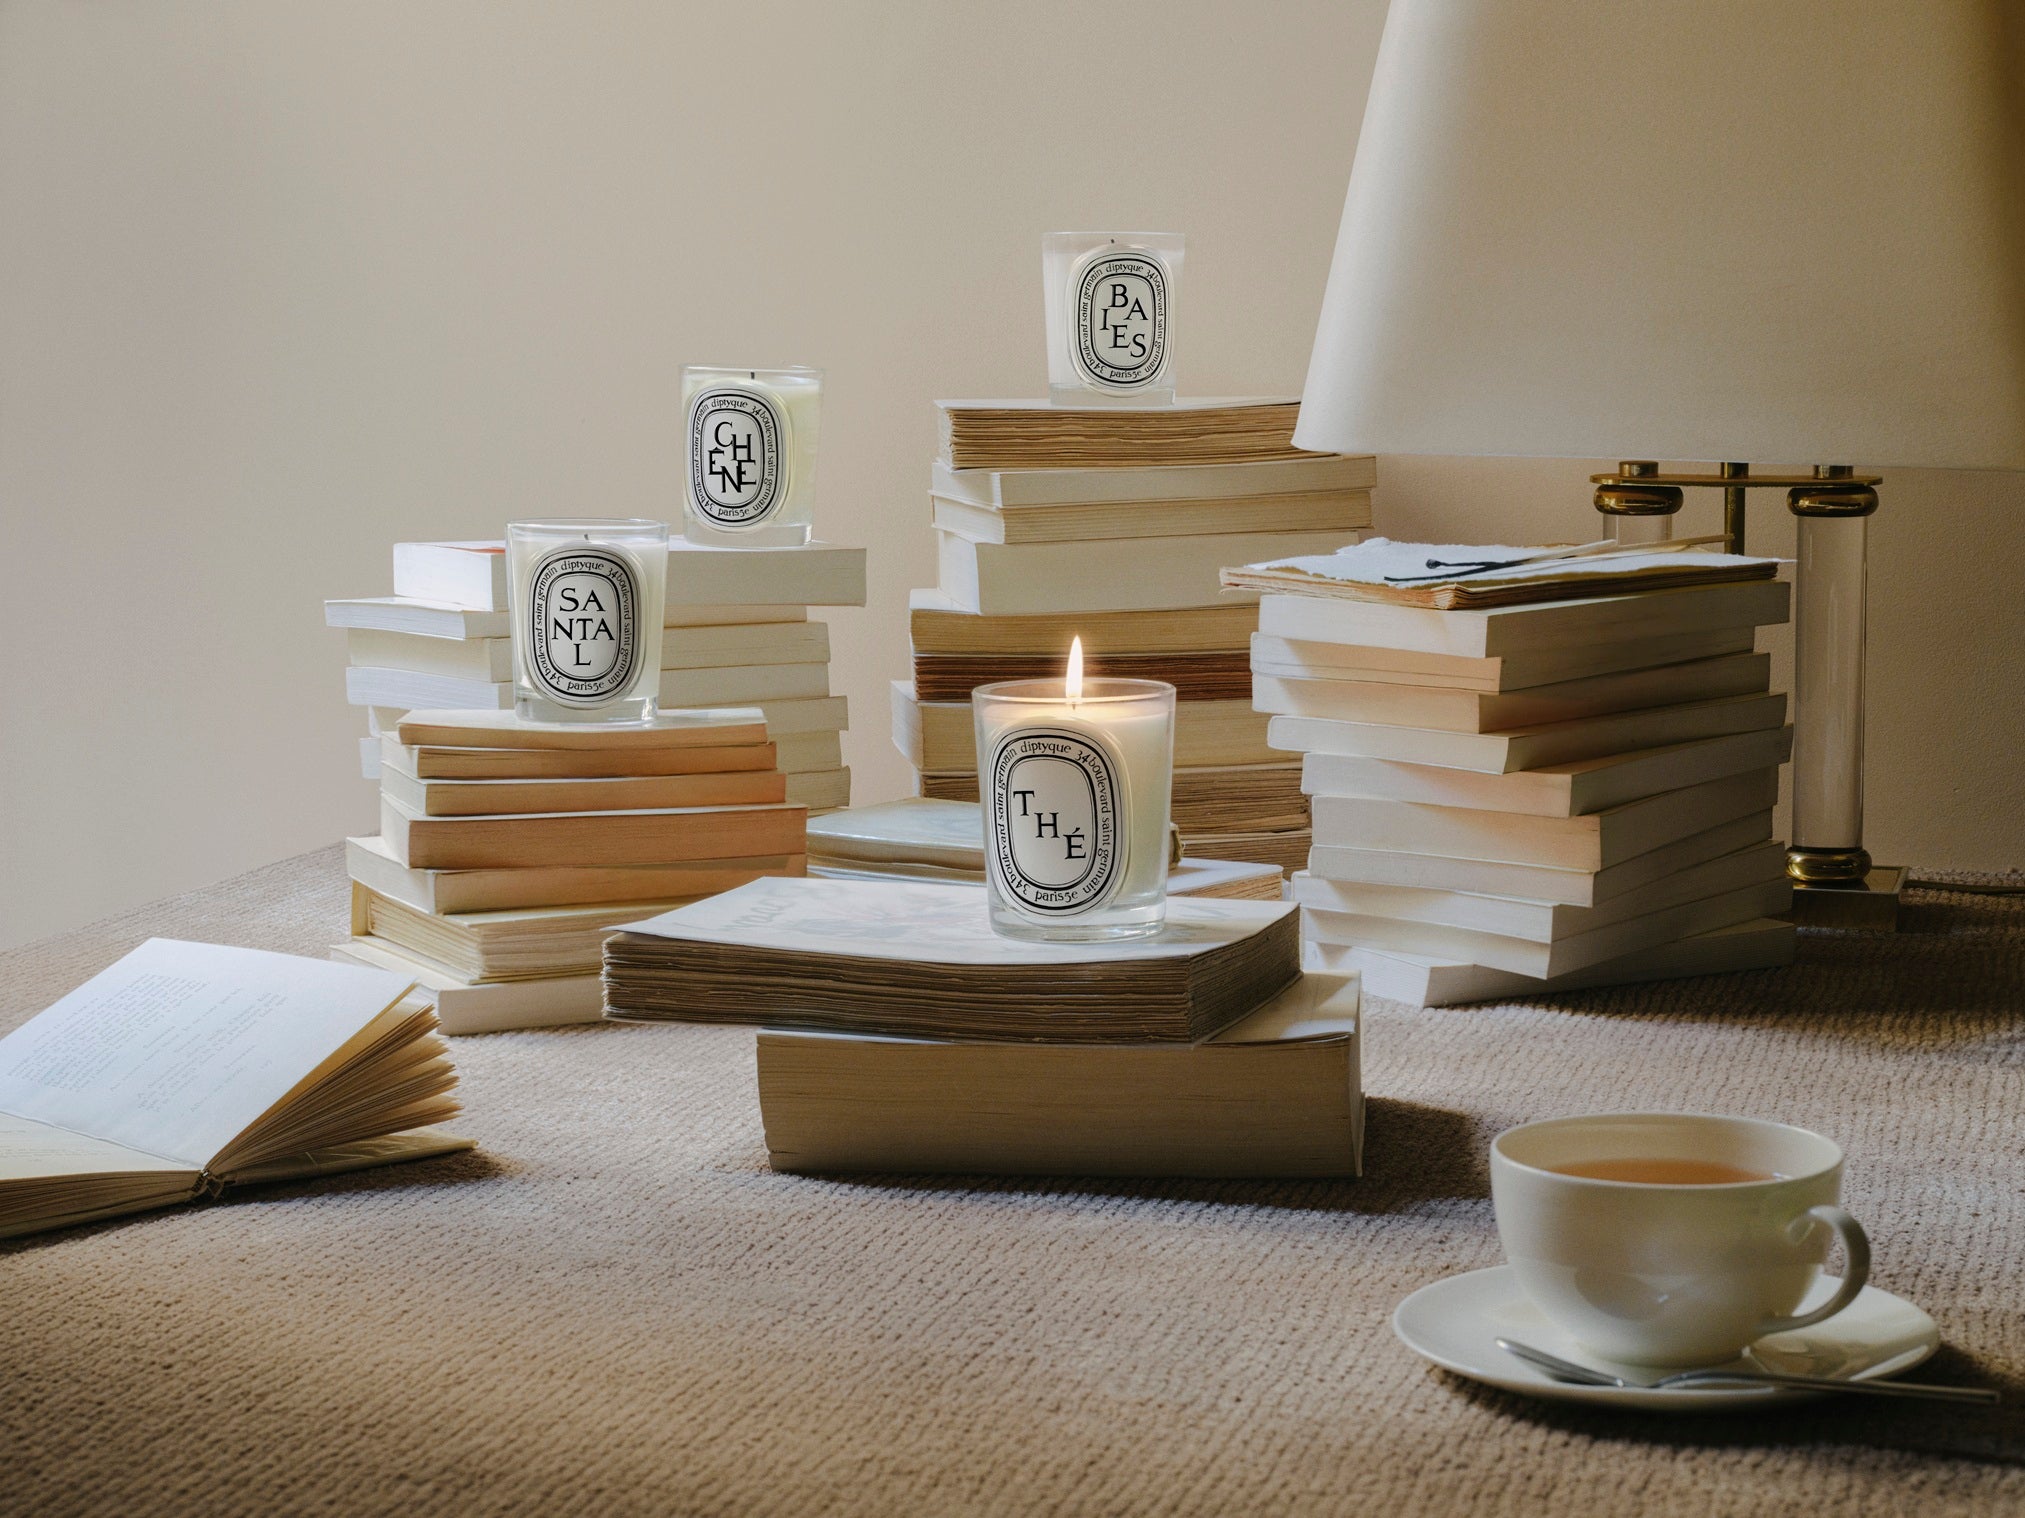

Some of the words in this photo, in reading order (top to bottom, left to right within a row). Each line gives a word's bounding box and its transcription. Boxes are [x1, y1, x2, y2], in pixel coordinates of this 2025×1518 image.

[1106, 264, 1143, 273] diptyque
[712, 399, 748, 408] diptyque
[561, 561, 604, 571] diptyque
[608, 648, 628, 685] germain
[1021, 741, 1071, 754] diptyque
[998, 748, 1017, 790] germain
[1102, 817, 1110, 845] saint
[1082, 848, 1109, 894] germain
